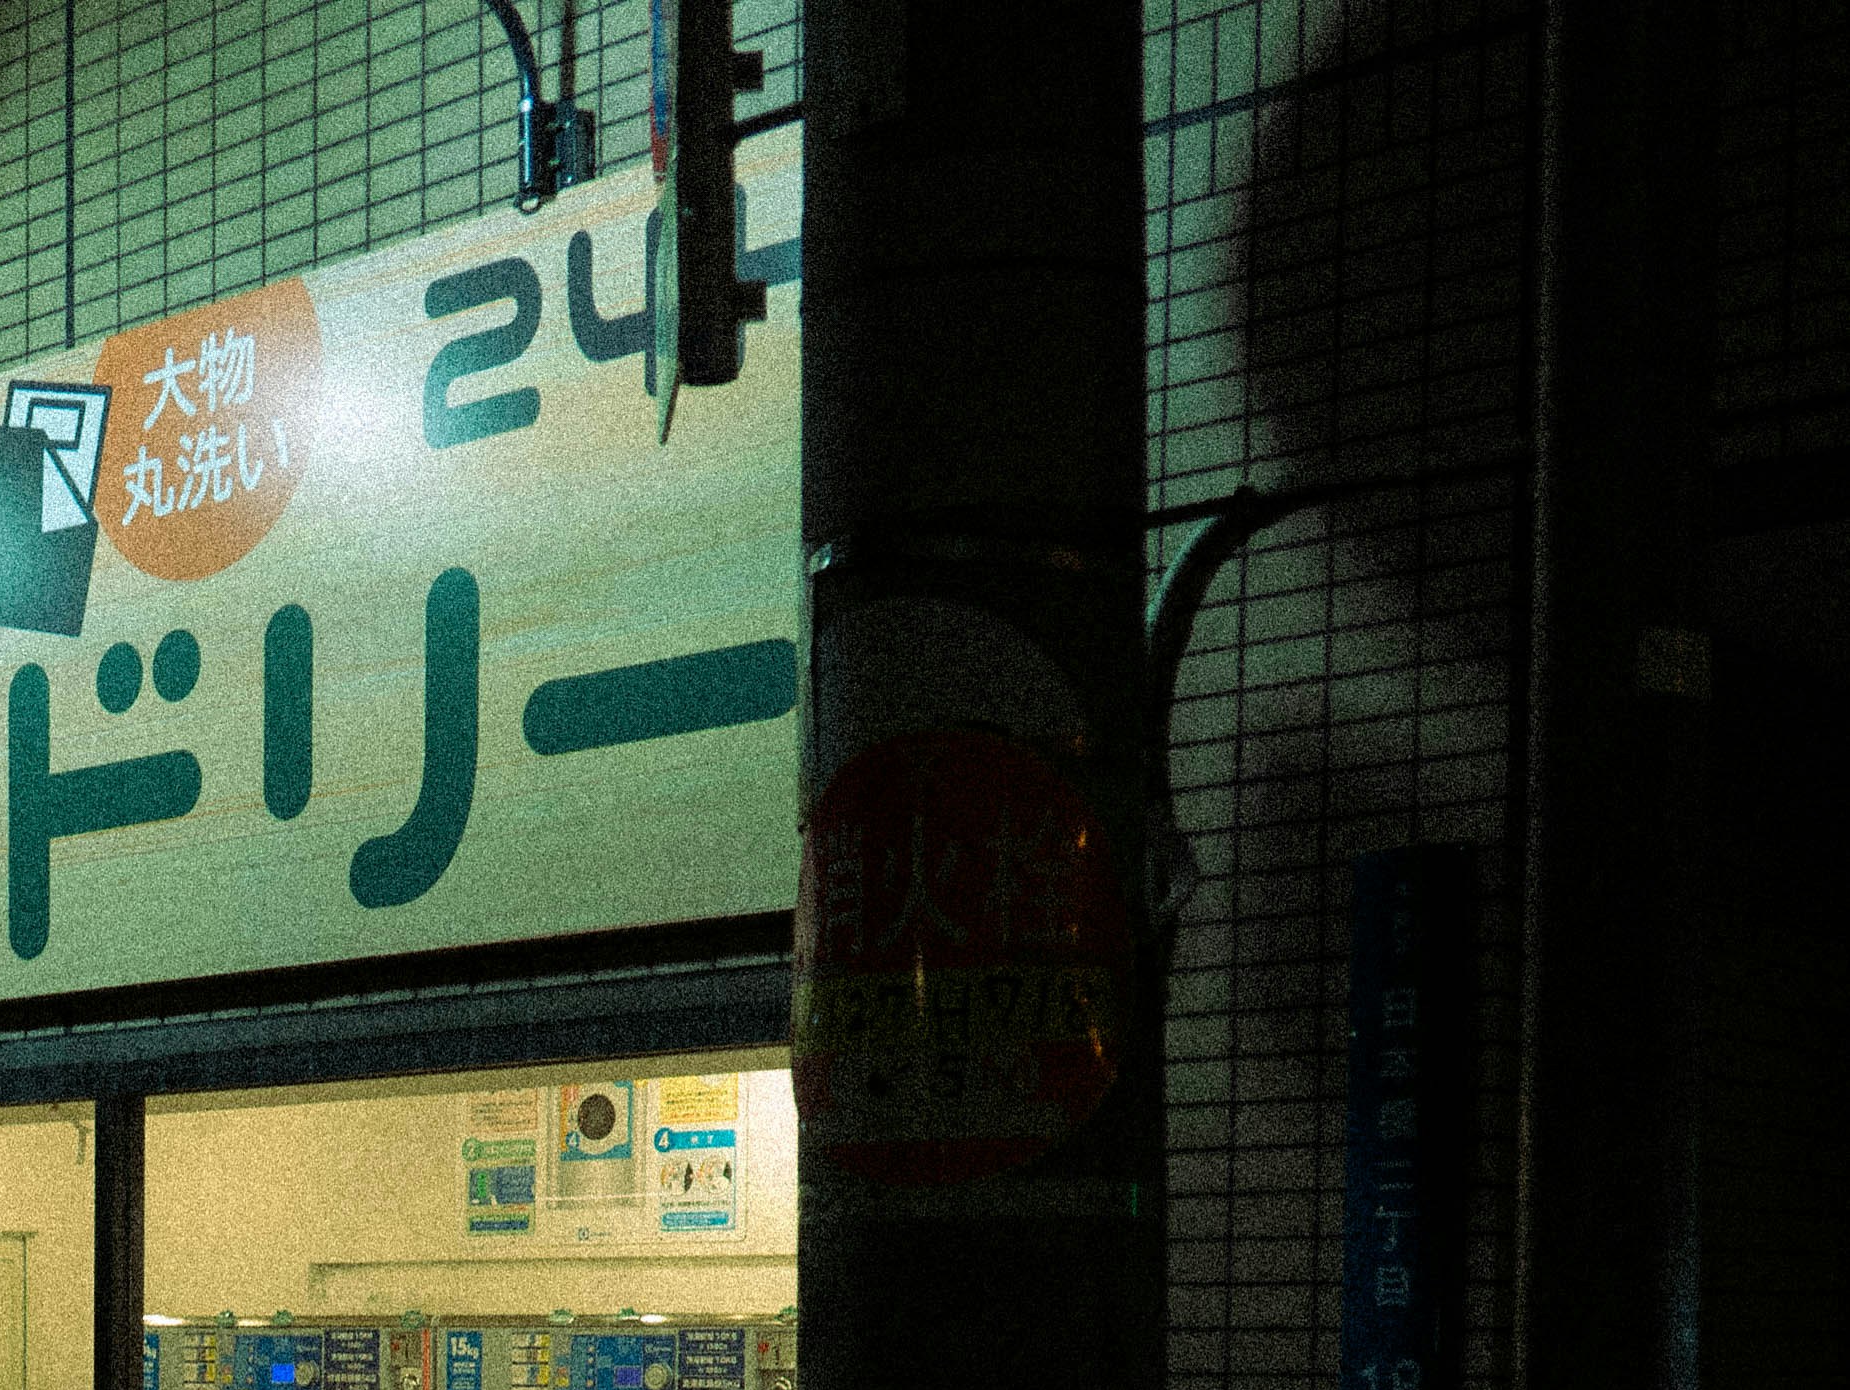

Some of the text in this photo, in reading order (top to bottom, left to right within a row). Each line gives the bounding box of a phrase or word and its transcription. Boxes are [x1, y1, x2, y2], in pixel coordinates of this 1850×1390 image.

[143, 325, 257, 430] 大物
[123, 422, 292, 527] 丸洗い
[822, 803, 1080, 958] 消火栓
[1376, 986, 1419, 1307] 日本橋二丁目
